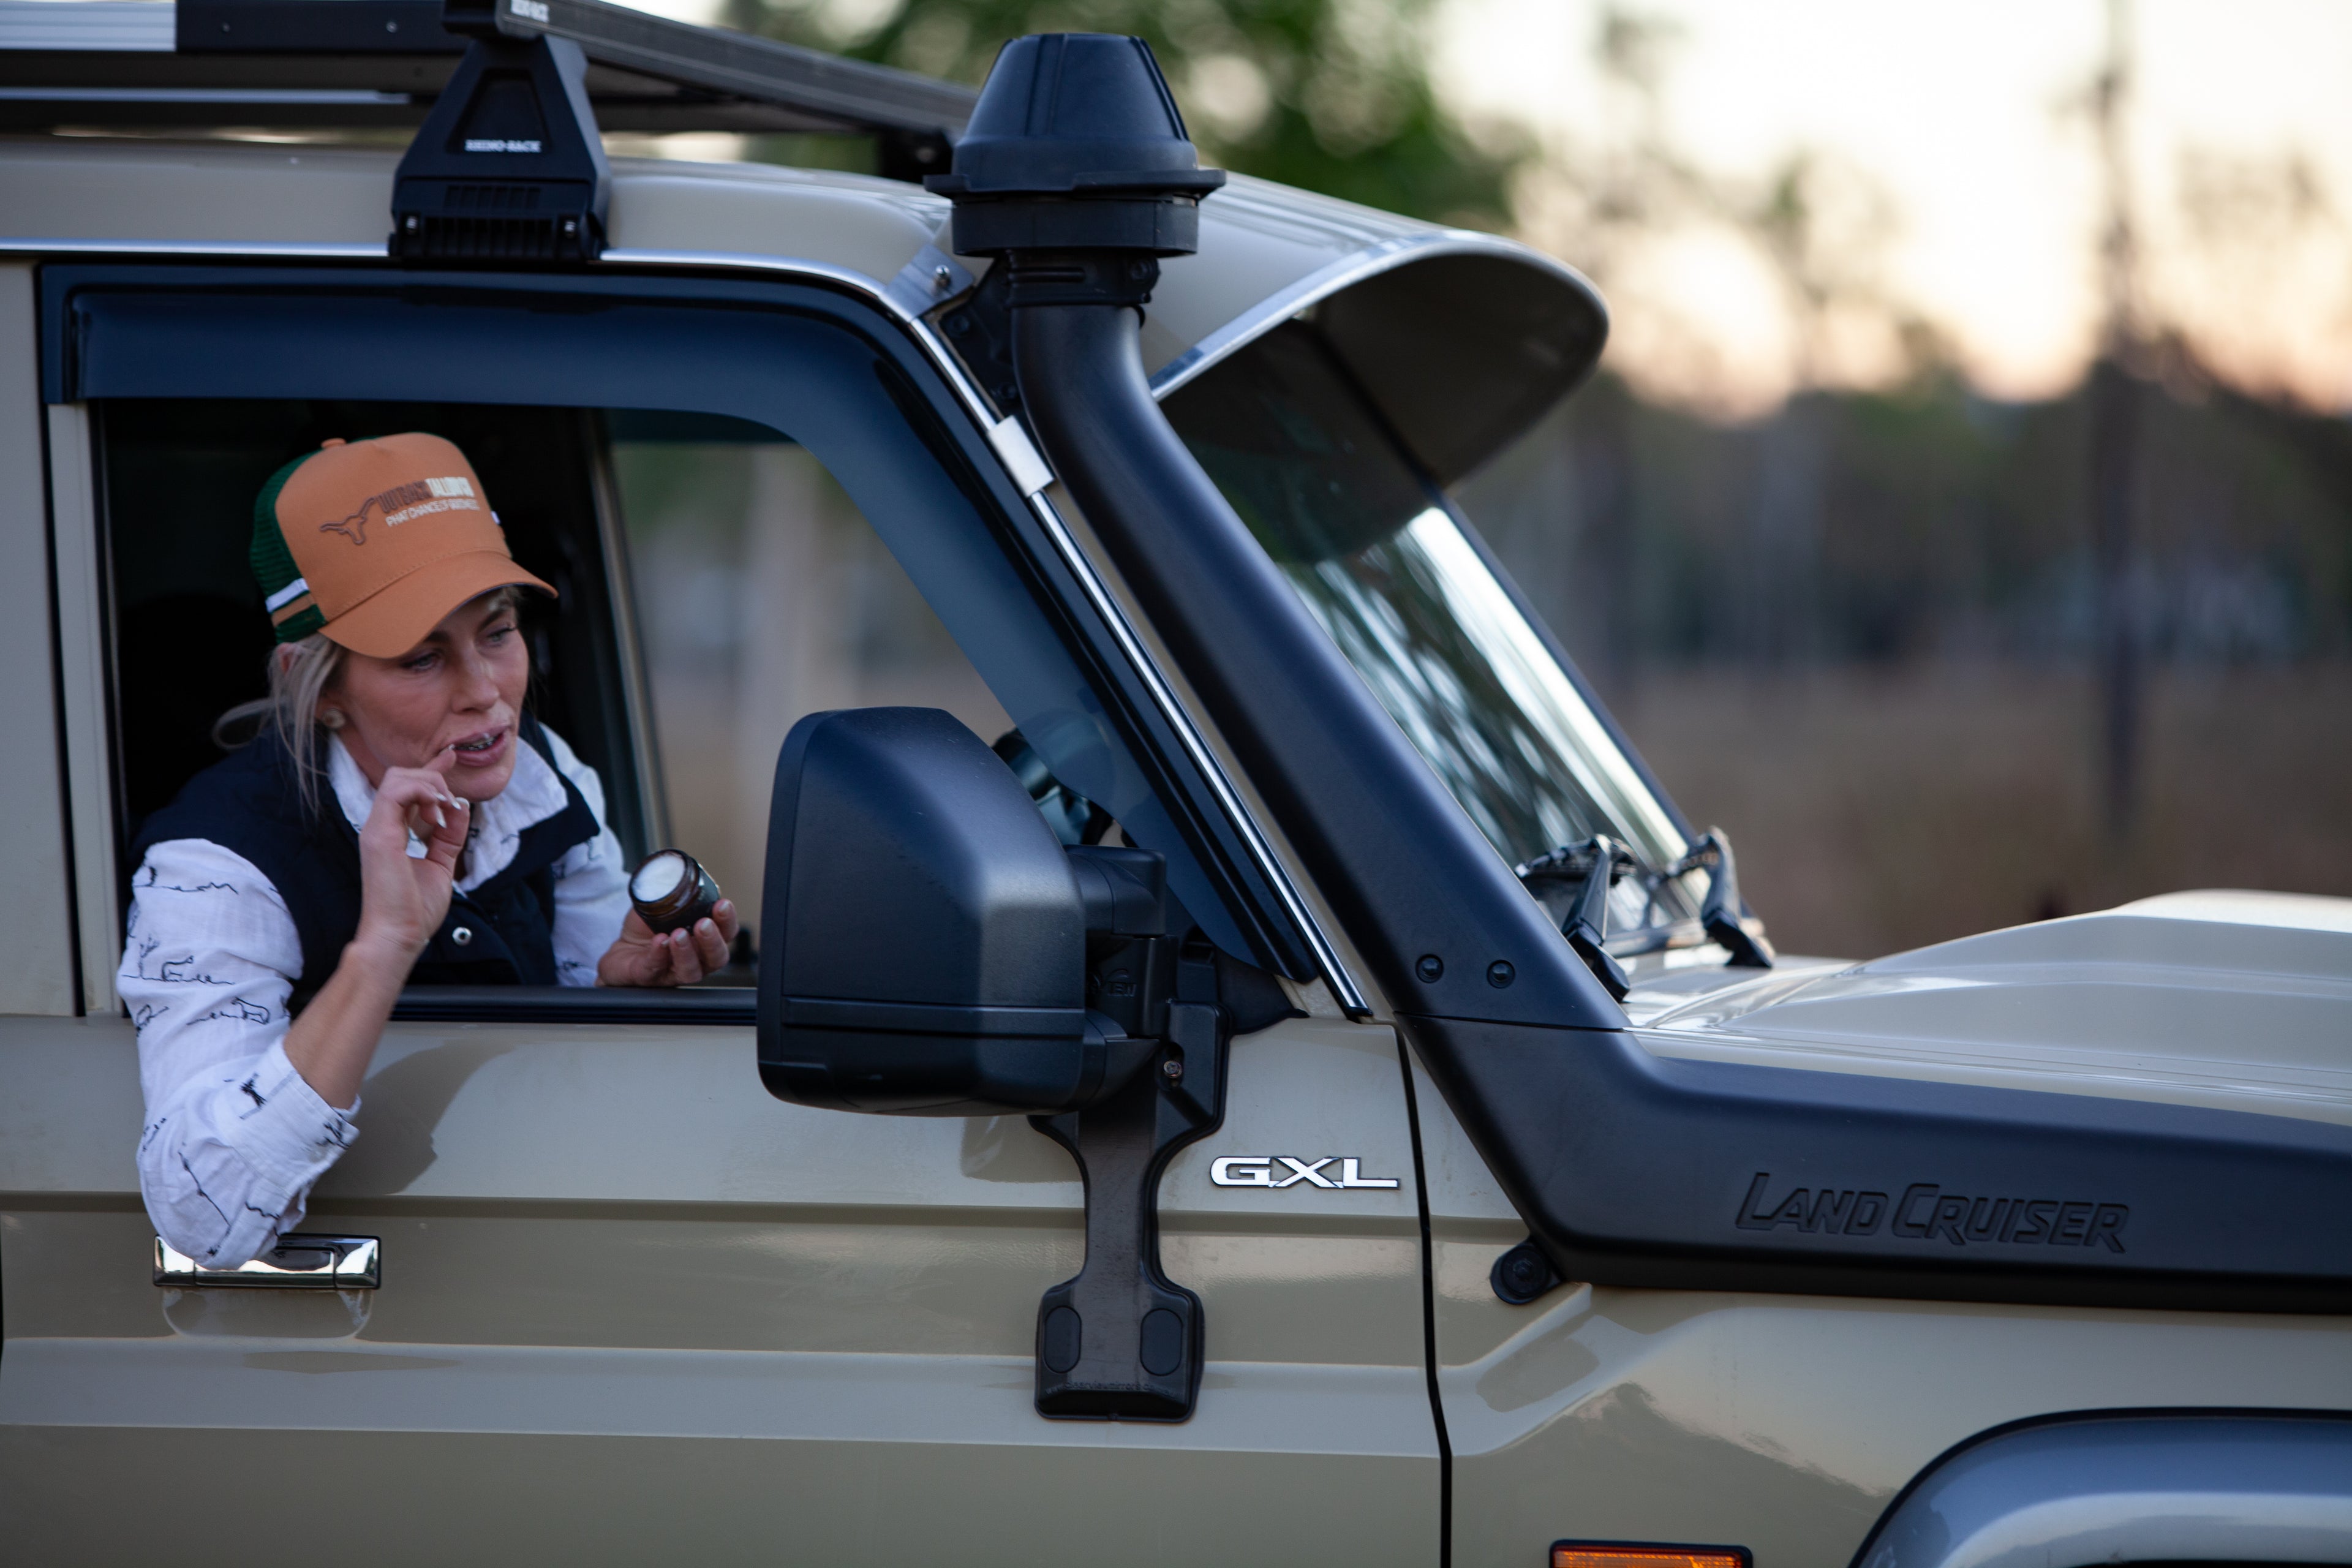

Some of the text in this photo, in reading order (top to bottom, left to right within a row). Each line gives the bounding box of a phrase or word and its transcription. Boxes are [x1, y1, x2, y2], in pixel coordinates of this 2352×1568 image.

[1210, 1156, 1400, 1189] GXL
[1735, 1171, 2130, 1254] LAND CRUISER
